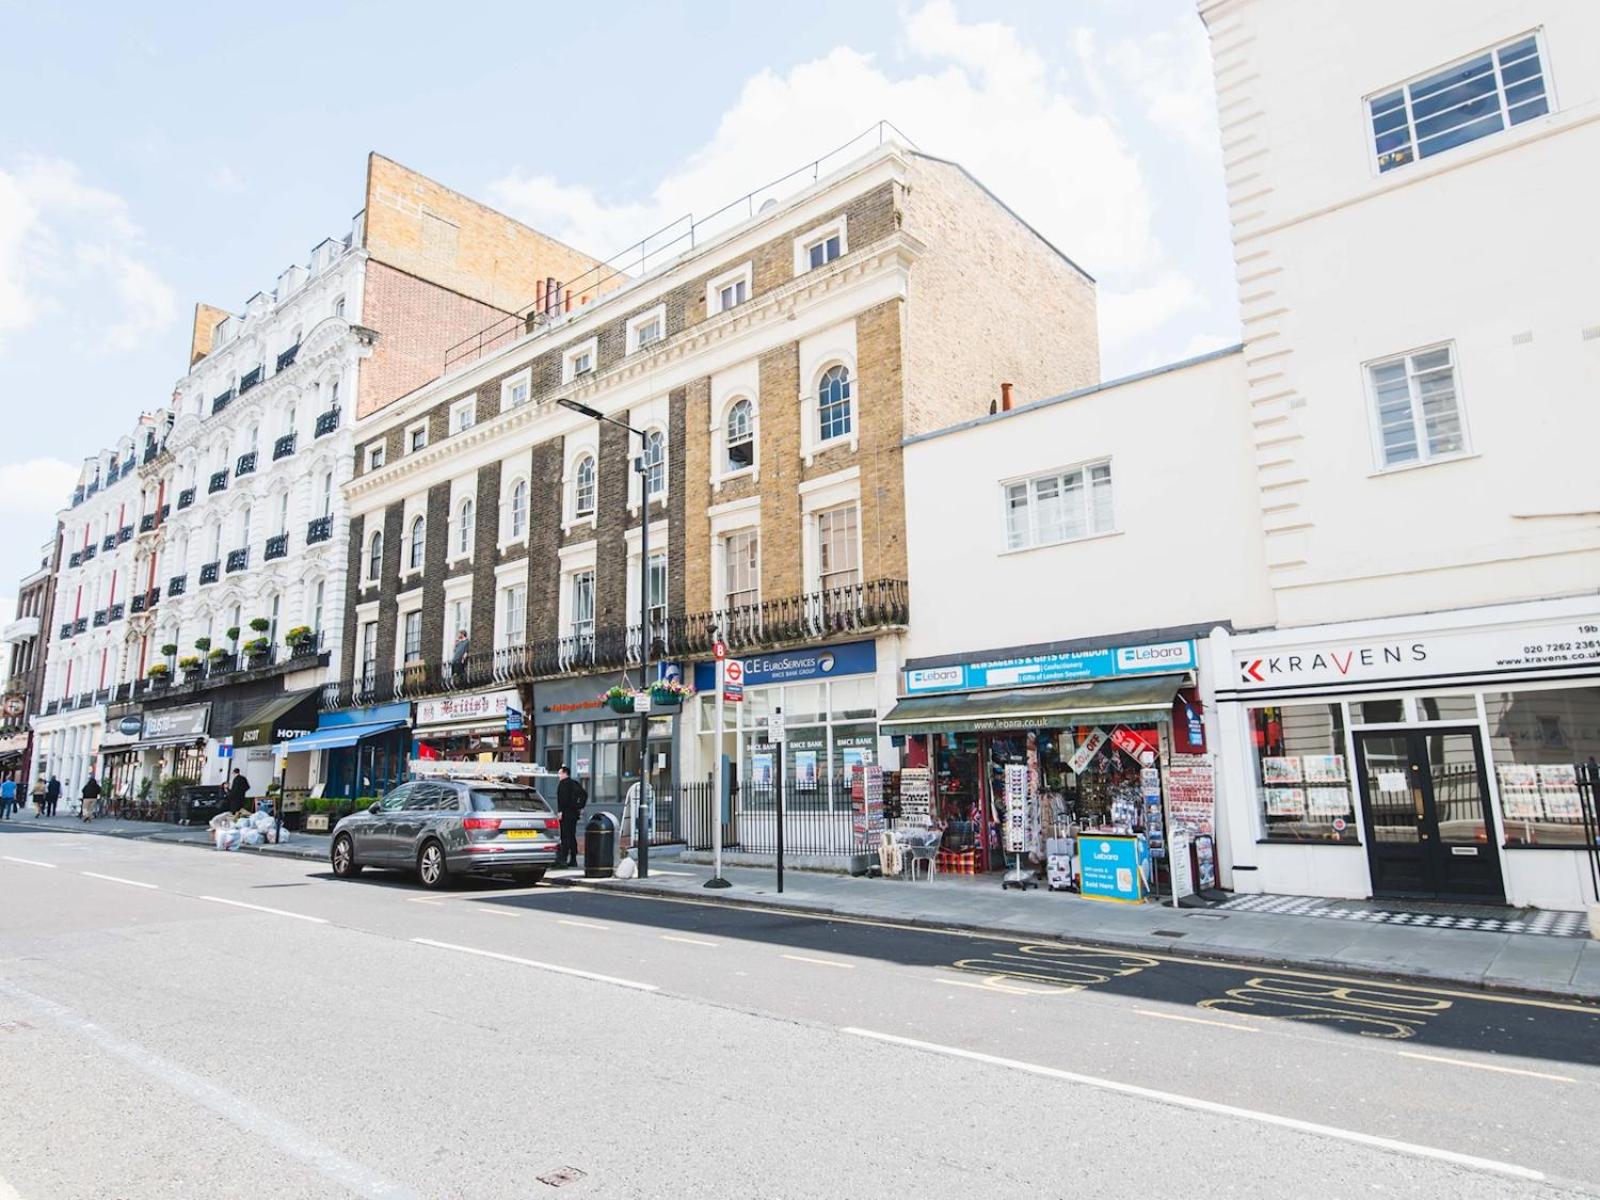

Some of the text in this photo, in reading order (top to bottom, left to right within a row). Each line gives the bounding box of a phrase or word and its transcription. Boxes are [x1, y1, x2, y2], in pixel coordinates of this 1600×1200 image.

[1578, 625, 1598, 634] 19b
[717, 644, 724, 657] B
[1136, 646, 1183, 660] Lebara
[1524, 645, 1543, 654] 020
[1547, 642, 1572, 652] 7262
[1269, 644, 1427, 674] KRAVENS
[922, 670, 958, 681] Lebara
[974, 717, 1049, 730] www.lebara.co.uk
[807, 740, 823, 748] BANK
[1086, 734, 1101, 752] OFF
